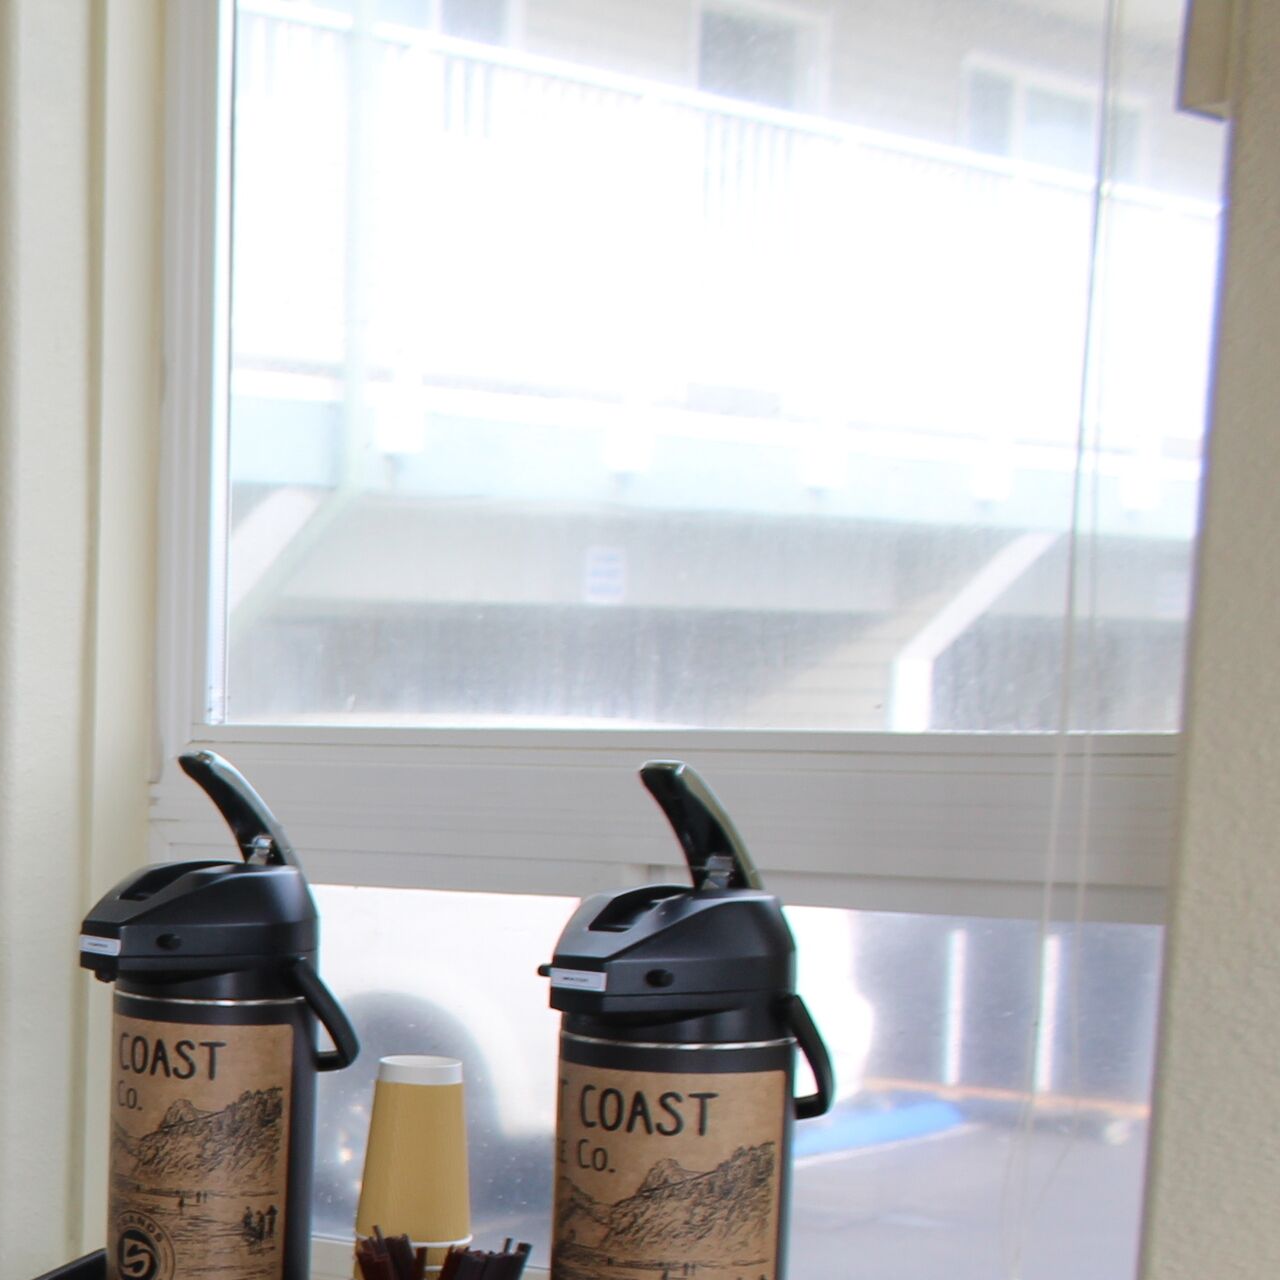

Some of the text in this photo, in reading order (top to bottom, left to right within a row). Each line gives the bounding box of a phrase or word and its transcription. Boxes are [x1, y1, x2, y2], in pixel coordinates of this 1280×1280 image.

[119, 1032, 226, 1080] COAST
[580, 1084, 718, 1136] COAST
[578, 1139, 615, 1173] Co.
